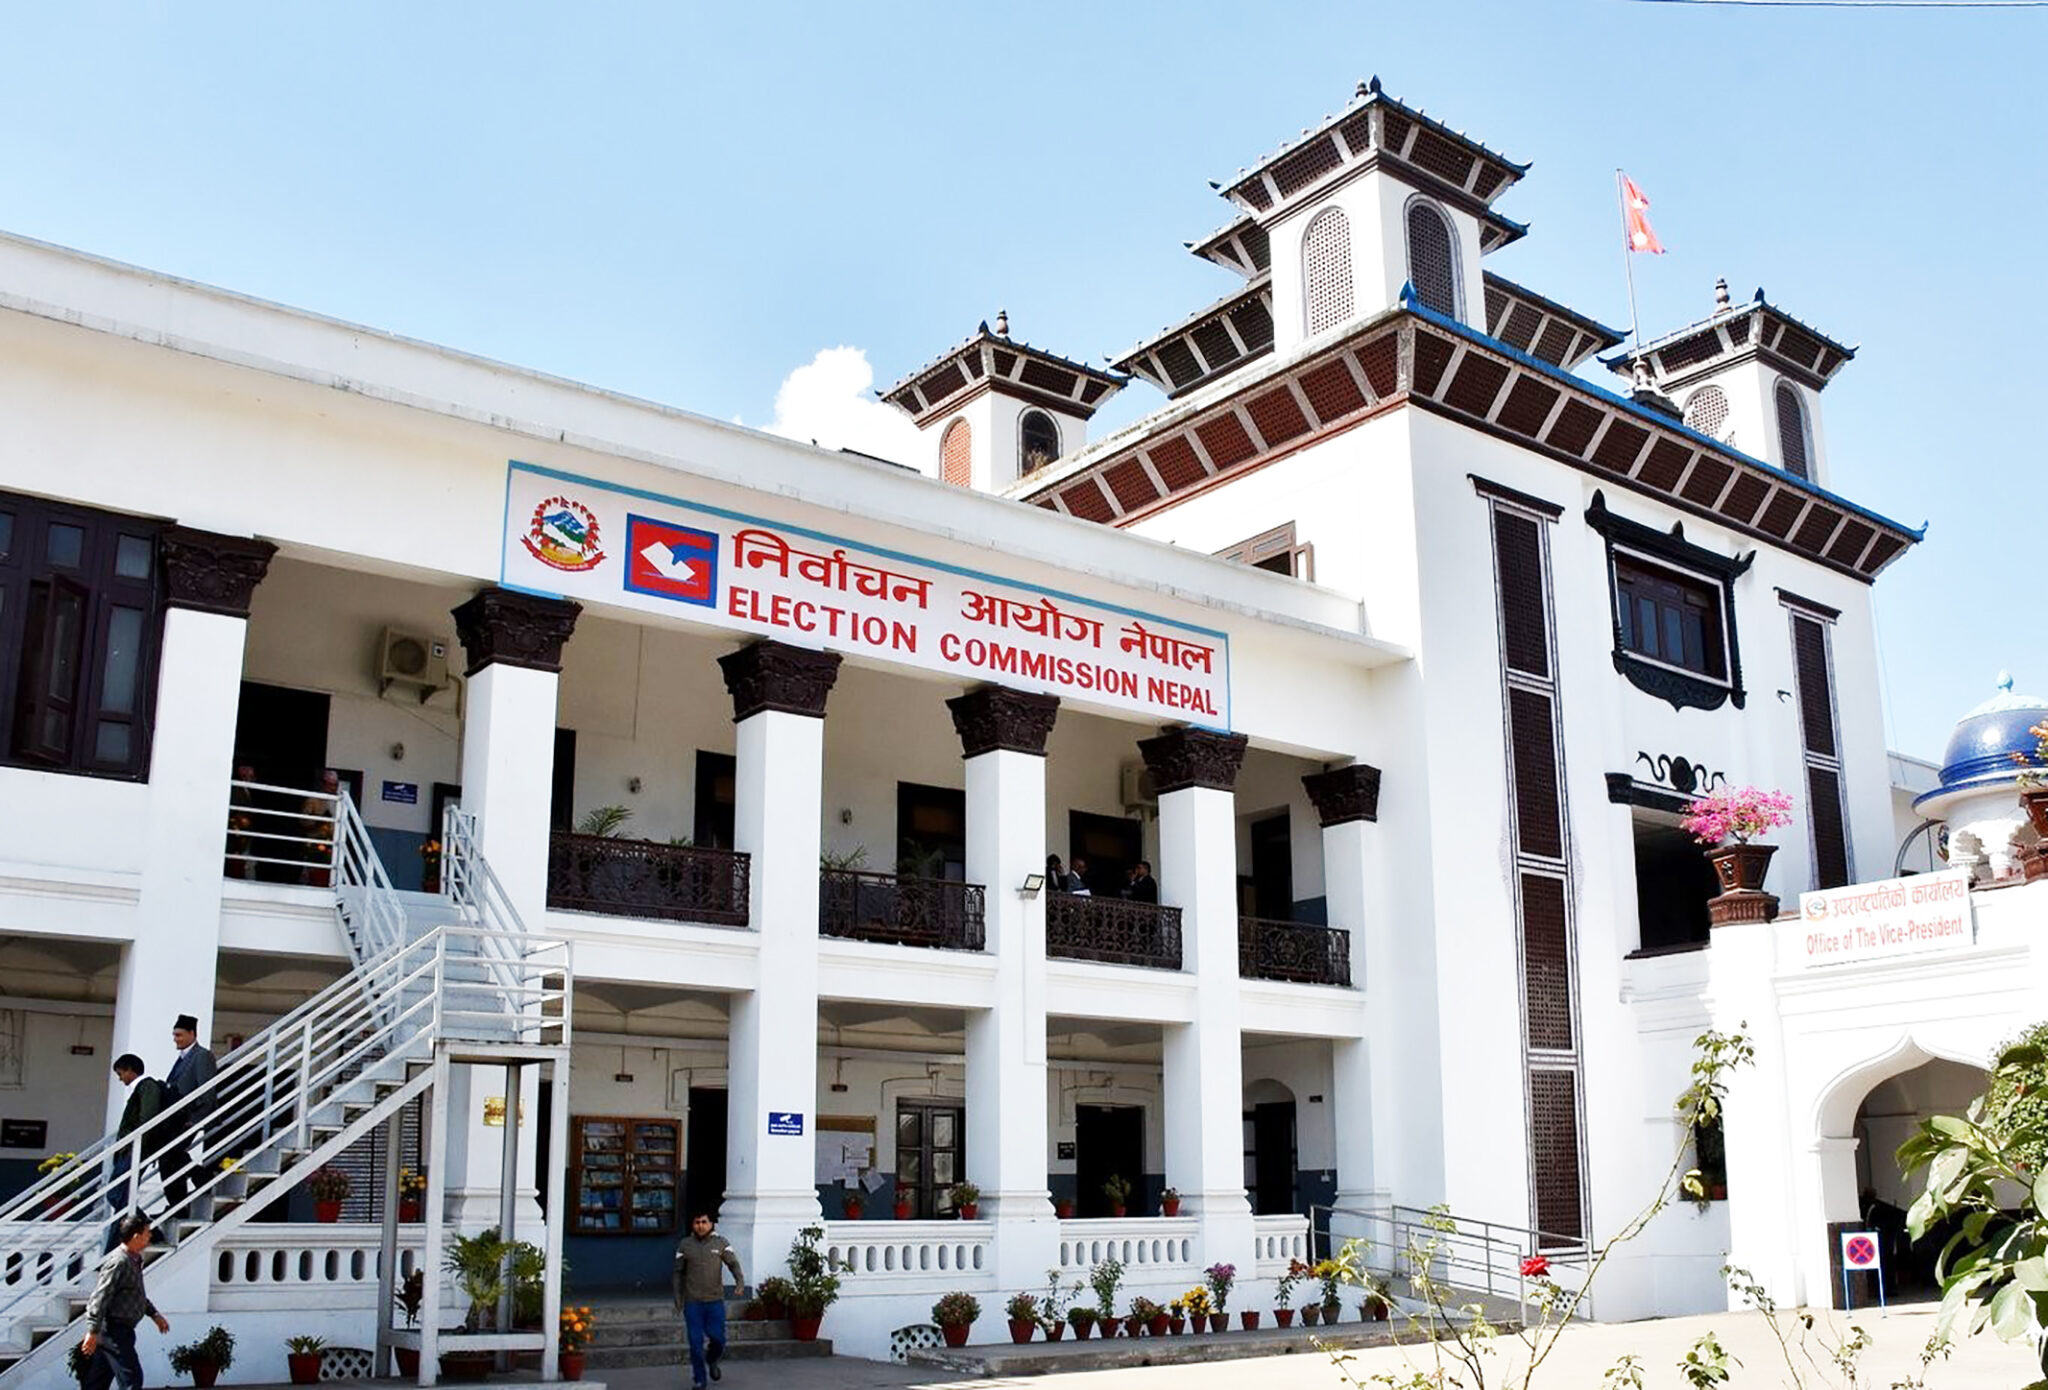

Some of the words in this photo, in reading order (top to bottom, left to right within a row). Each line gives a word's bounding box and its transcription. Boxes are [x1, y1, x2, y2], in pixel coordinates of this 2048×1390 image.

[731, 528, 933, 610] निर्वाचन
[961, 590, 1103, 648] आयोग
[1120, 621, 1214, 674] नेपाल
[728, 585, 917, 654] ELECTION
[940, 633, 1139, 699] COMMISSION
[1147, 676, 1218, 716] NEPAL
[1911, 876, 1964, 905] कार्यालय
[1806, 931, 1839, 956] Office
[1843, 928, 1853, 951] of
[1856, 925, 1877, 948] The
[1878, 914, 1964, 946] Vice-President
